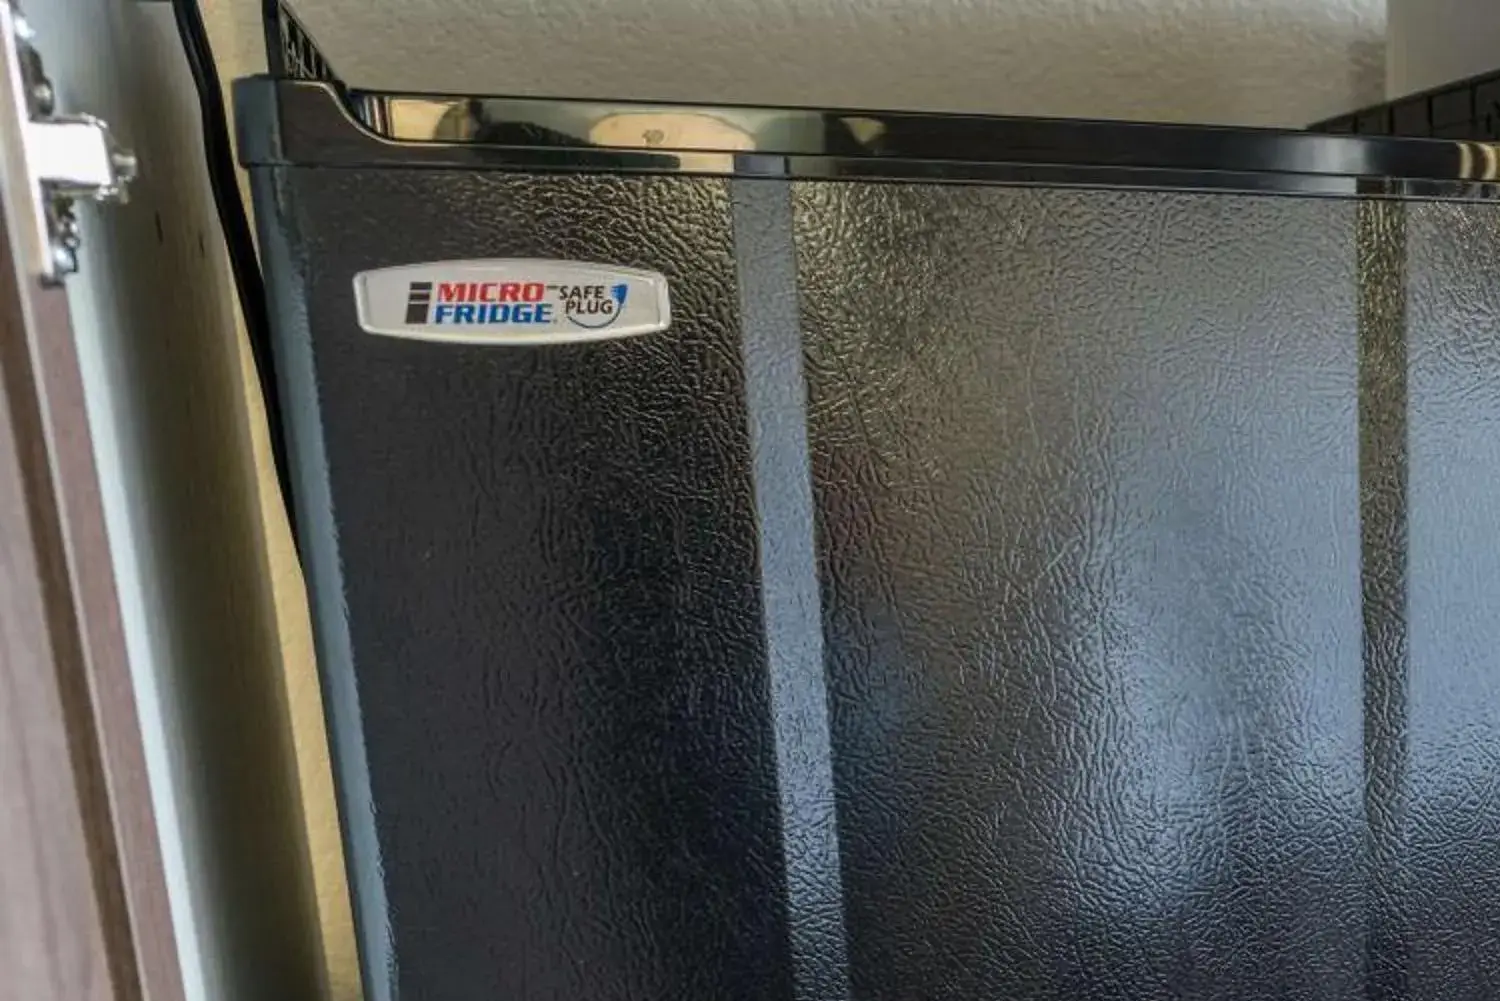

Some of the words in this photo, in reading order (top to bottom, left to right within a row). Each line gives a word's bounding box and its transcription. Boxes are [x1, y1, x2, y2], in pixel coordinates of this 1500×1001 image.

[437, 281, 546, 302] MICRO
[559, 284, 605, 301] SAFE
[434, 303, 553, 325] FRIDGE
[564, 299, 613, 315] PLUG
